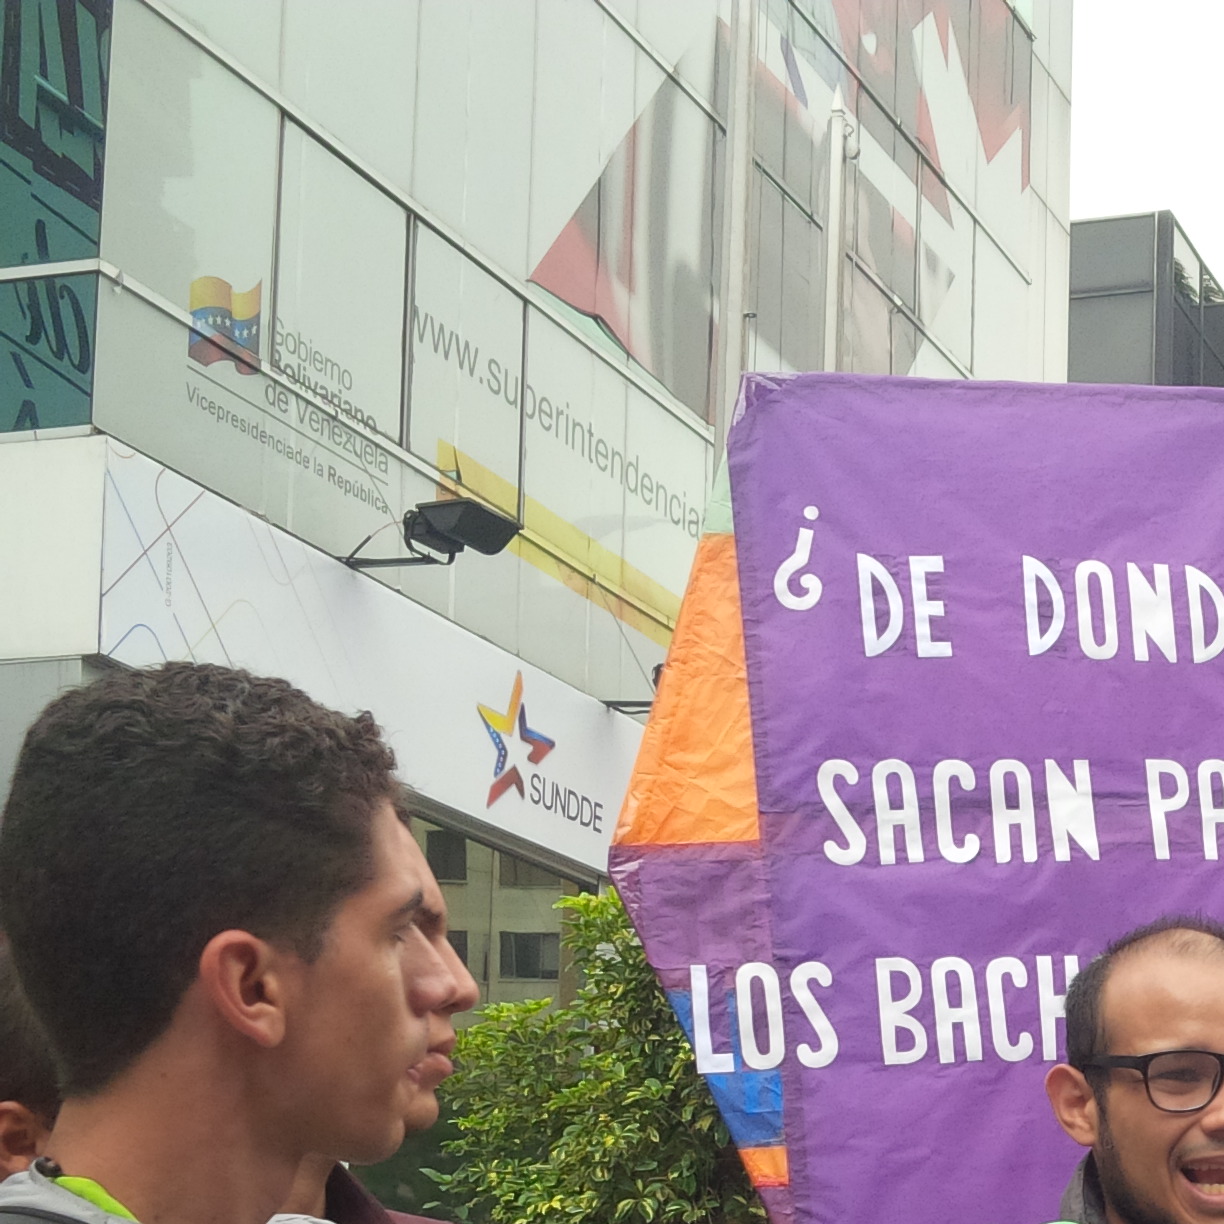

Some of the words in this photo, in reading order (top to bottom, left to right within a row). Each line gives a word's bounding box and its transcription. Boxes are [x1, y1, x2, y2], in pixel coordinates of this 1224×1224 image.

[264, 382, 289, 414] de
[294, 393, 389, 475] Venezuela
[411, 305, 706, 541] www.superintendencia
[313, 456, 324, 478] la
[327, 465, 389, 515] República
[530, 773, 604, 834] SUNDDE
[817, 759, 1100, 866] SACAN
[690, 961, 839, 1074] LOS
